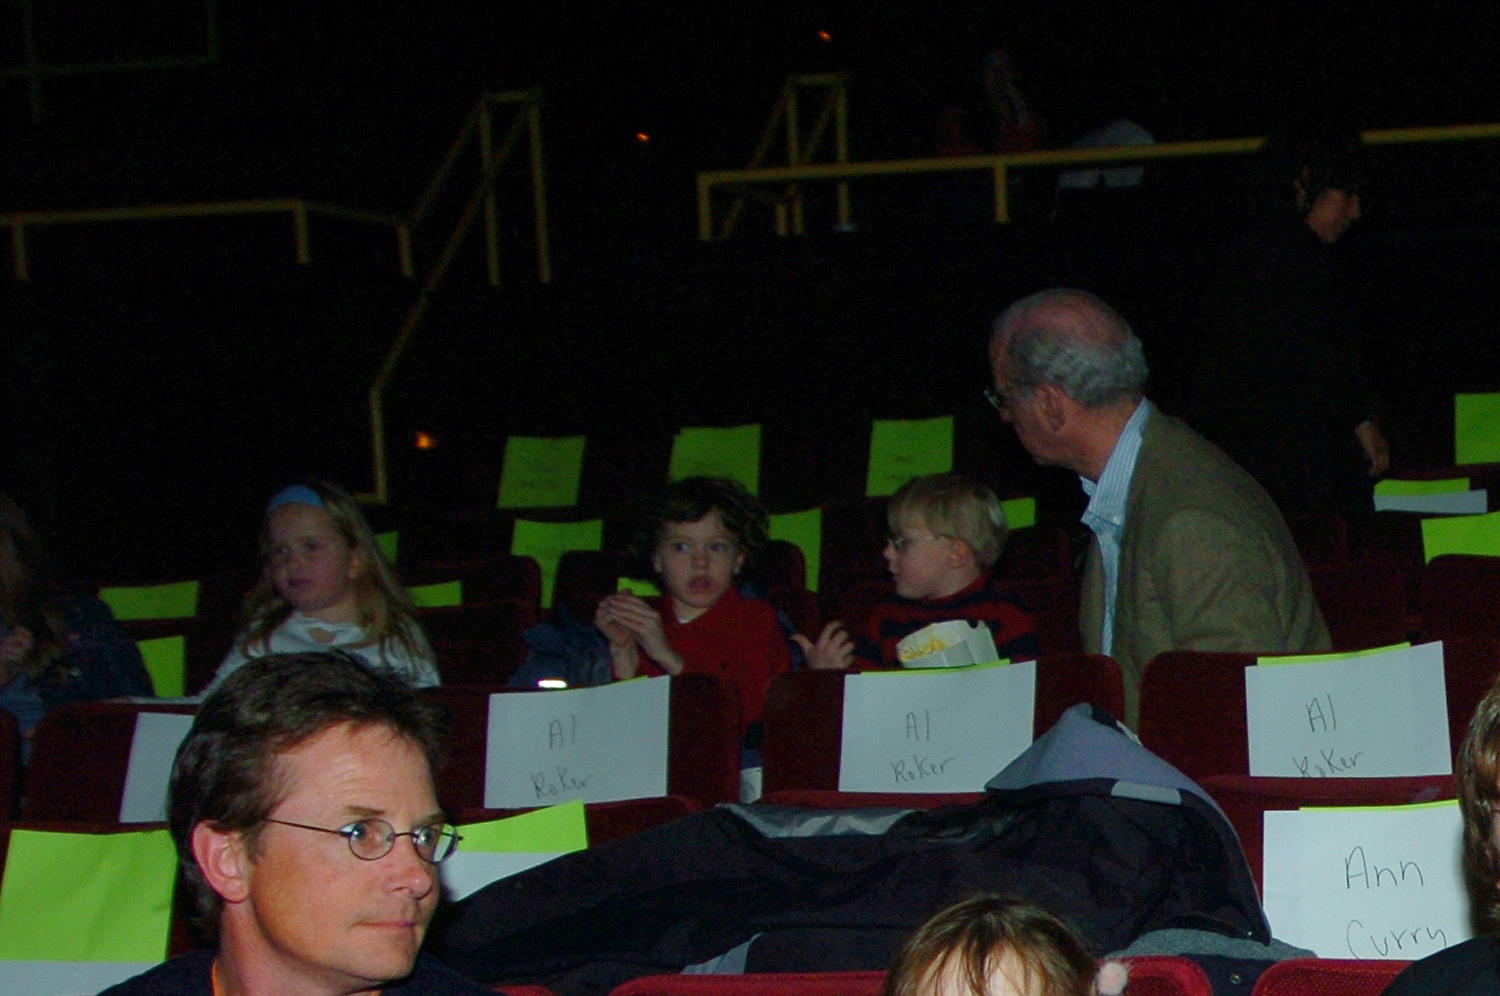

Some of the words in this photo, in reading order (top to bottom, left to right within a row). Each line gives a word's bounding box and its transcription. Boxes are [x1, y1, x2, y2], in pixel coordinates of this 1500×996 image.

[548, 713, 577, 750] Al
[905, 708, 931, 742] Al
[1305, 692, 1338, 733] Al
[1344, 844, 1425, 890] Ann
[1345, 918, 1448, 959] Curry
